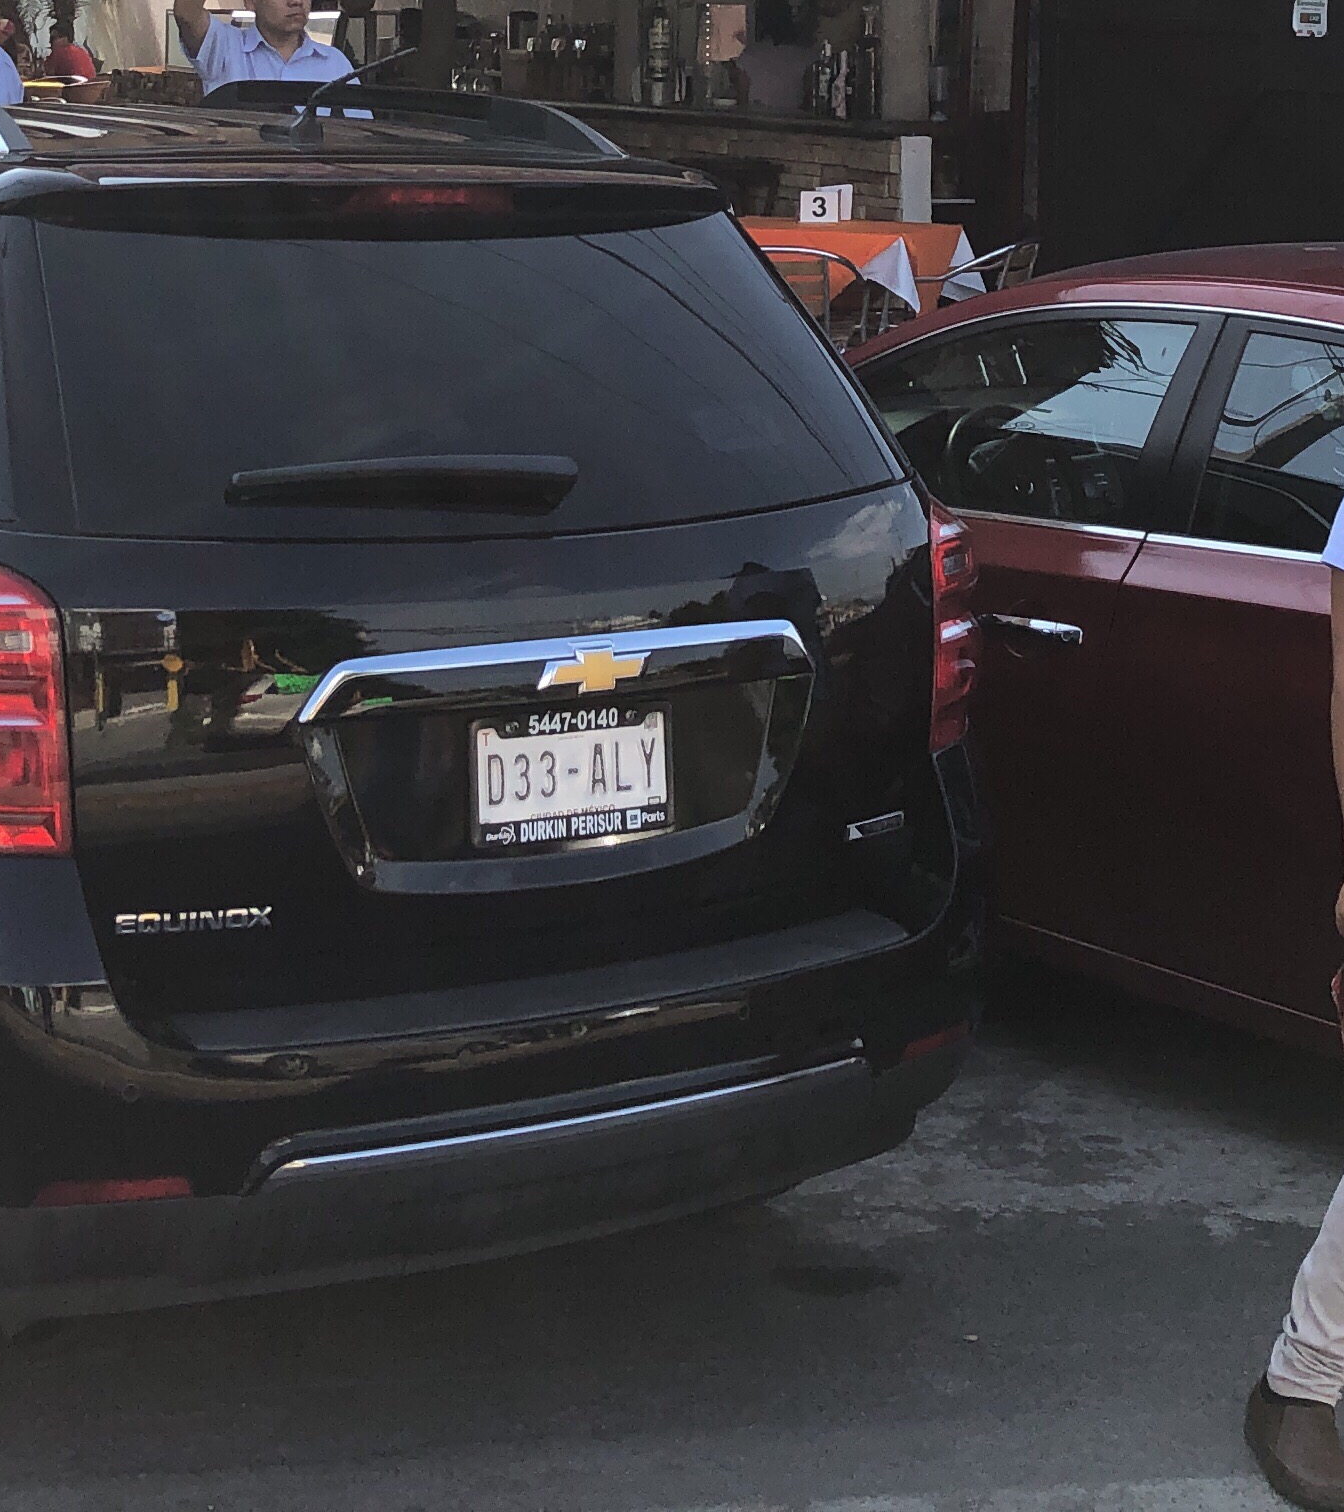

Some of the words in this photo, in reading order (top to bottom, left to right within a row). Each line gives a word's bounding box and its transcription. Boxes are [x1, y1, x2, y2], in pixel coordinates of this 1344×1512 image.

[812, 196, 827, 218] 3
[528, 707, 619, 735] 5447-0140
[487, 737, 656, 806] D33-ALY
[519, 816, 567, 843] DURKIN
[570, 810, 623, 837] PERISUR
[641, 810, 666, 824] Parts
[115, 906, 273, 935] EQUINOX
